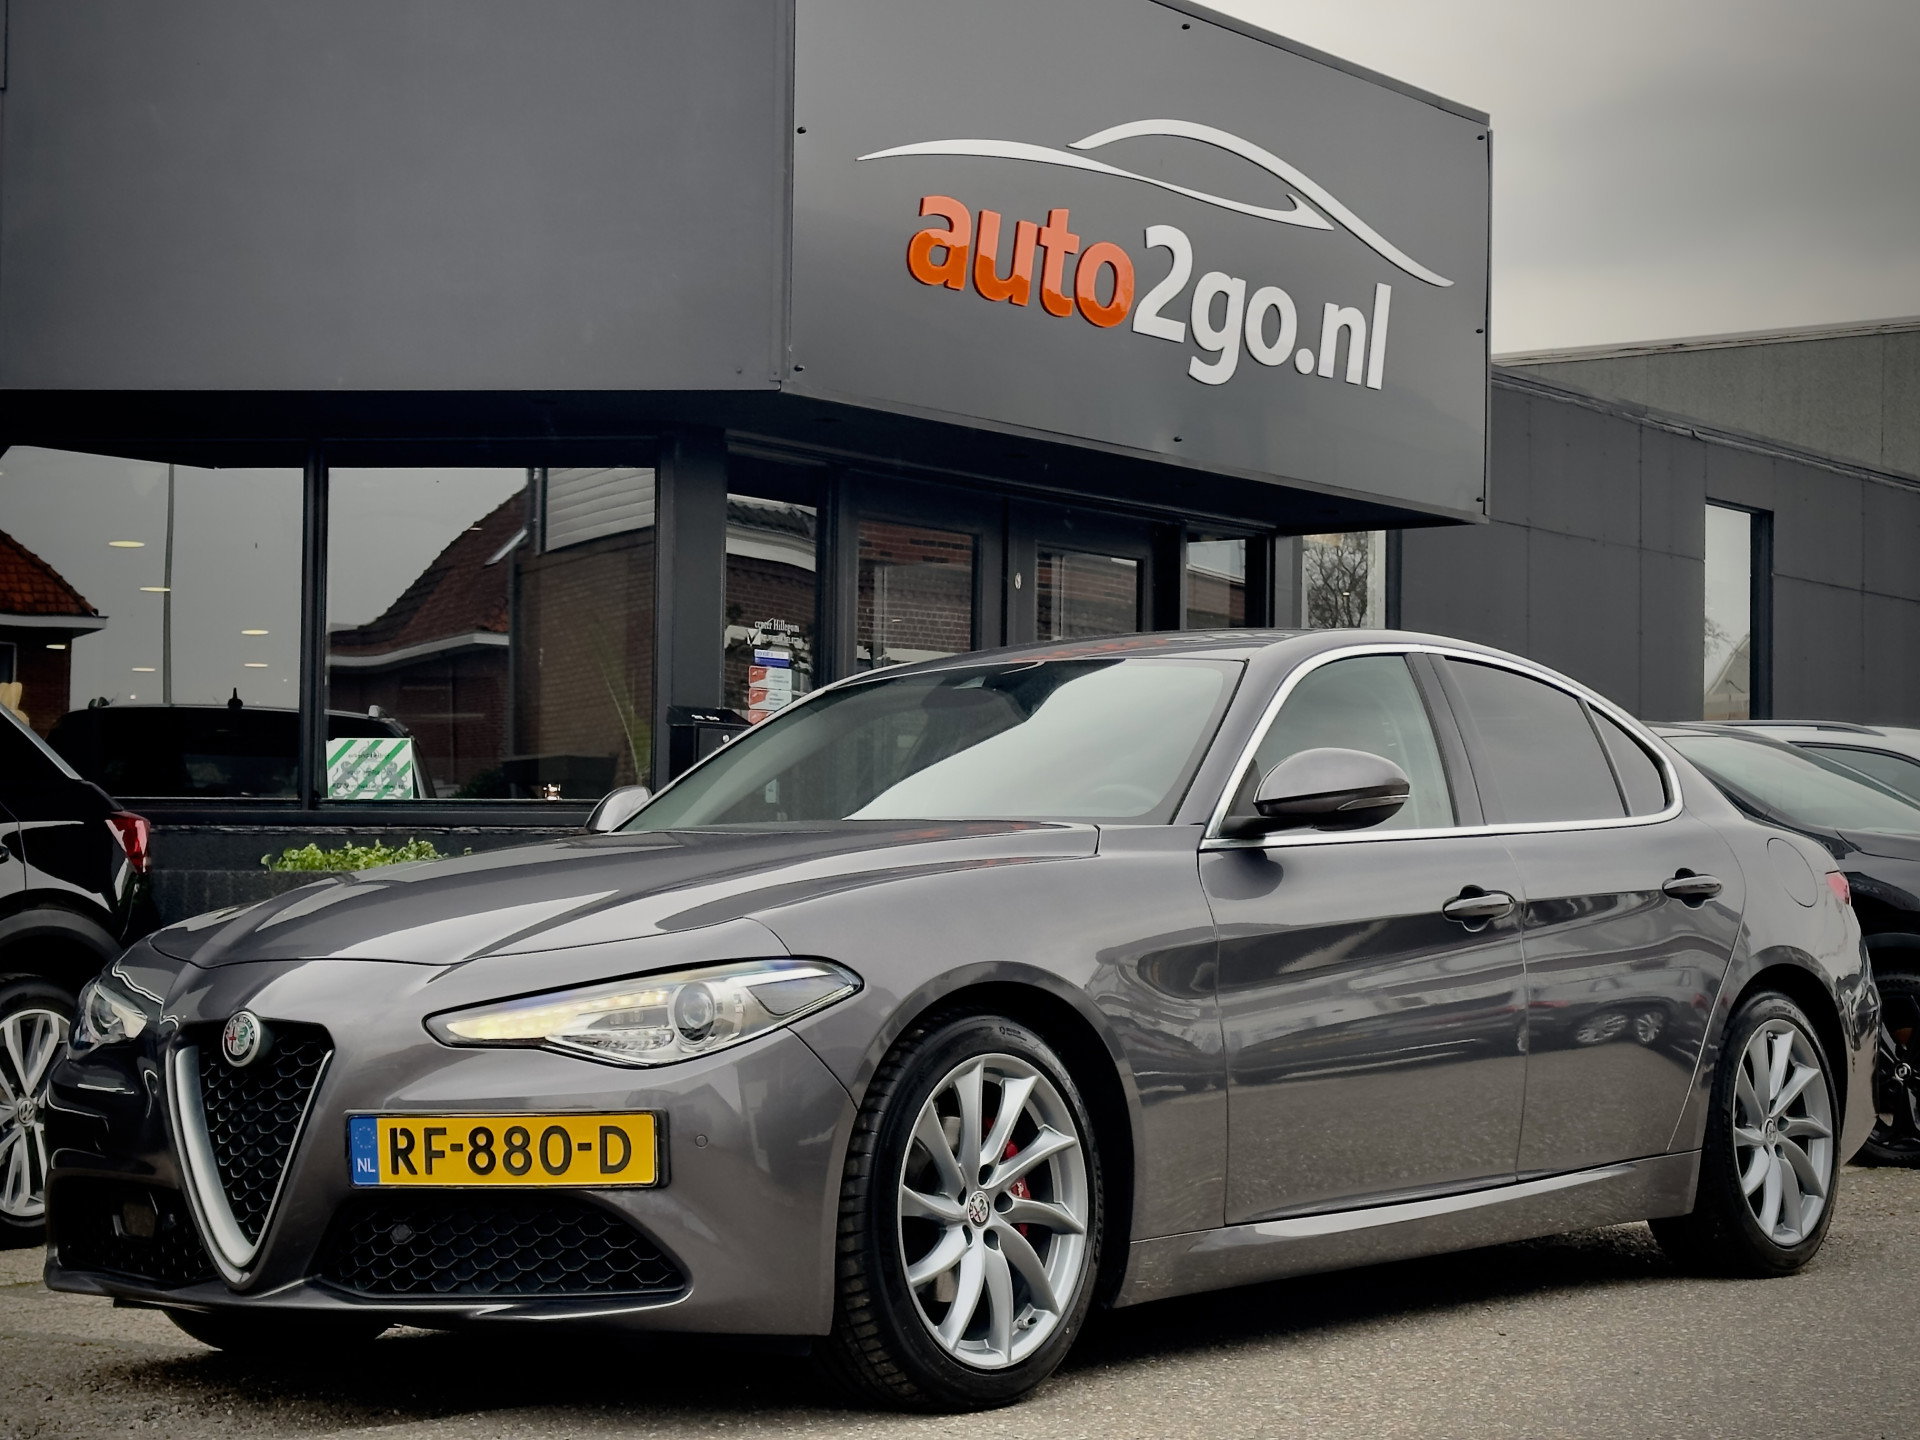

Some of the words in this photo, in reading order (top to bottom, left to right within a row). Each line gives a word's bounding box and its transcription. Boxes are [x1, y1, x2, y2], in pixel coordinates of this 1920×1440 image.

[906, 195, 1392, 391] auto2go.nl
[357, 1157, 376, 1173] NL
[389, 1125, 632, 1176] RF-880-D
